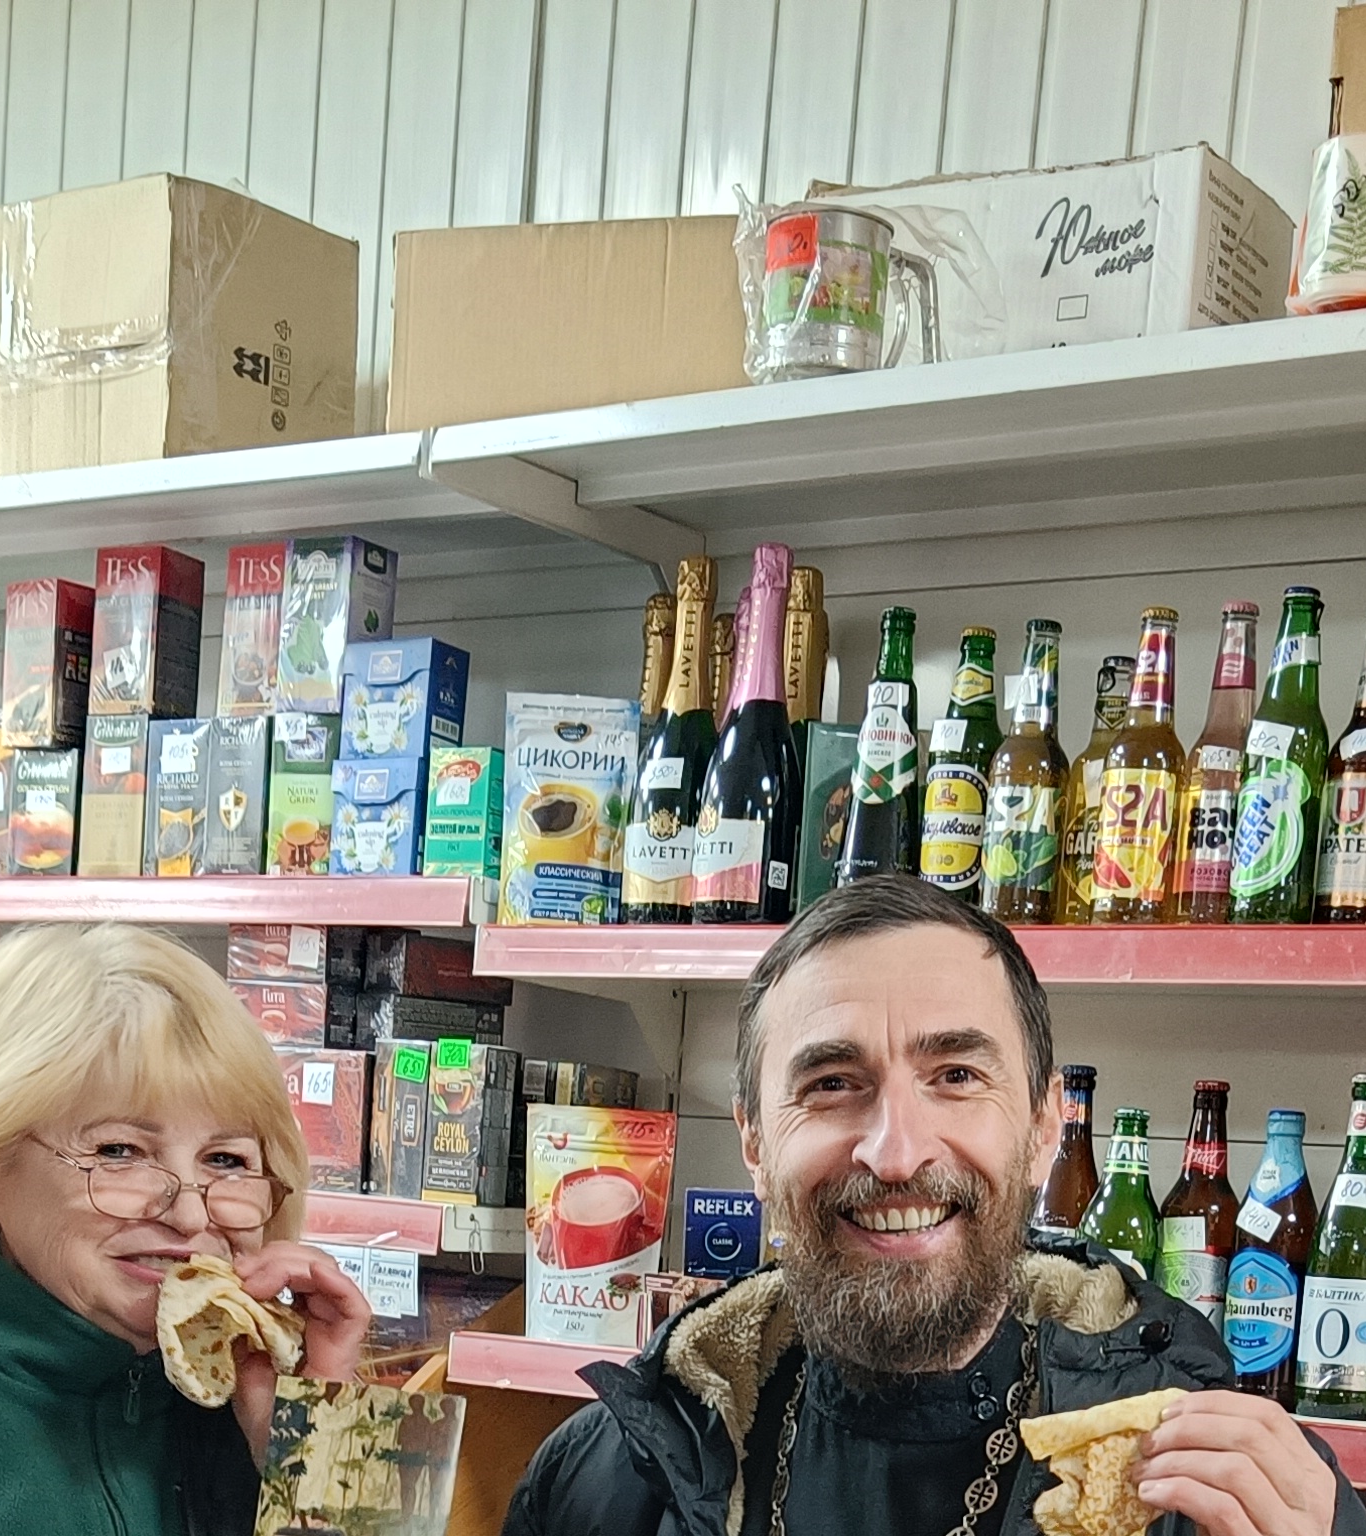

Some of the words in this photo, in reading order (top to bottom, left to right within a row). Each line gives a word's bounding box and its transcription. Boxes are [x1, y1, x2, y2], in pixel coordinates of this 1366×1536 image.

[1094, 242, 1154, 278] море
[104, 557, 150, 585] TESS
[236, 556, 282, 585] TESS
[156, 773, 199, 785] RICHARD
[287, 786, 319, 797] NATURE
[289, 795, 316, 805] GREEN
[632, 846, 690, 860] LAVETT
[404, 1104, 415, 1138] ETRE
[437, 1122, 466, 1139] ROYAL
[433, 1136, 469, 1154] CEYLON
[693, 1198, 755, 1217] REFLEX
[539, 1283, 630, 1312] КАКАО
[1237, 1322, 1257, 1333] WIT
